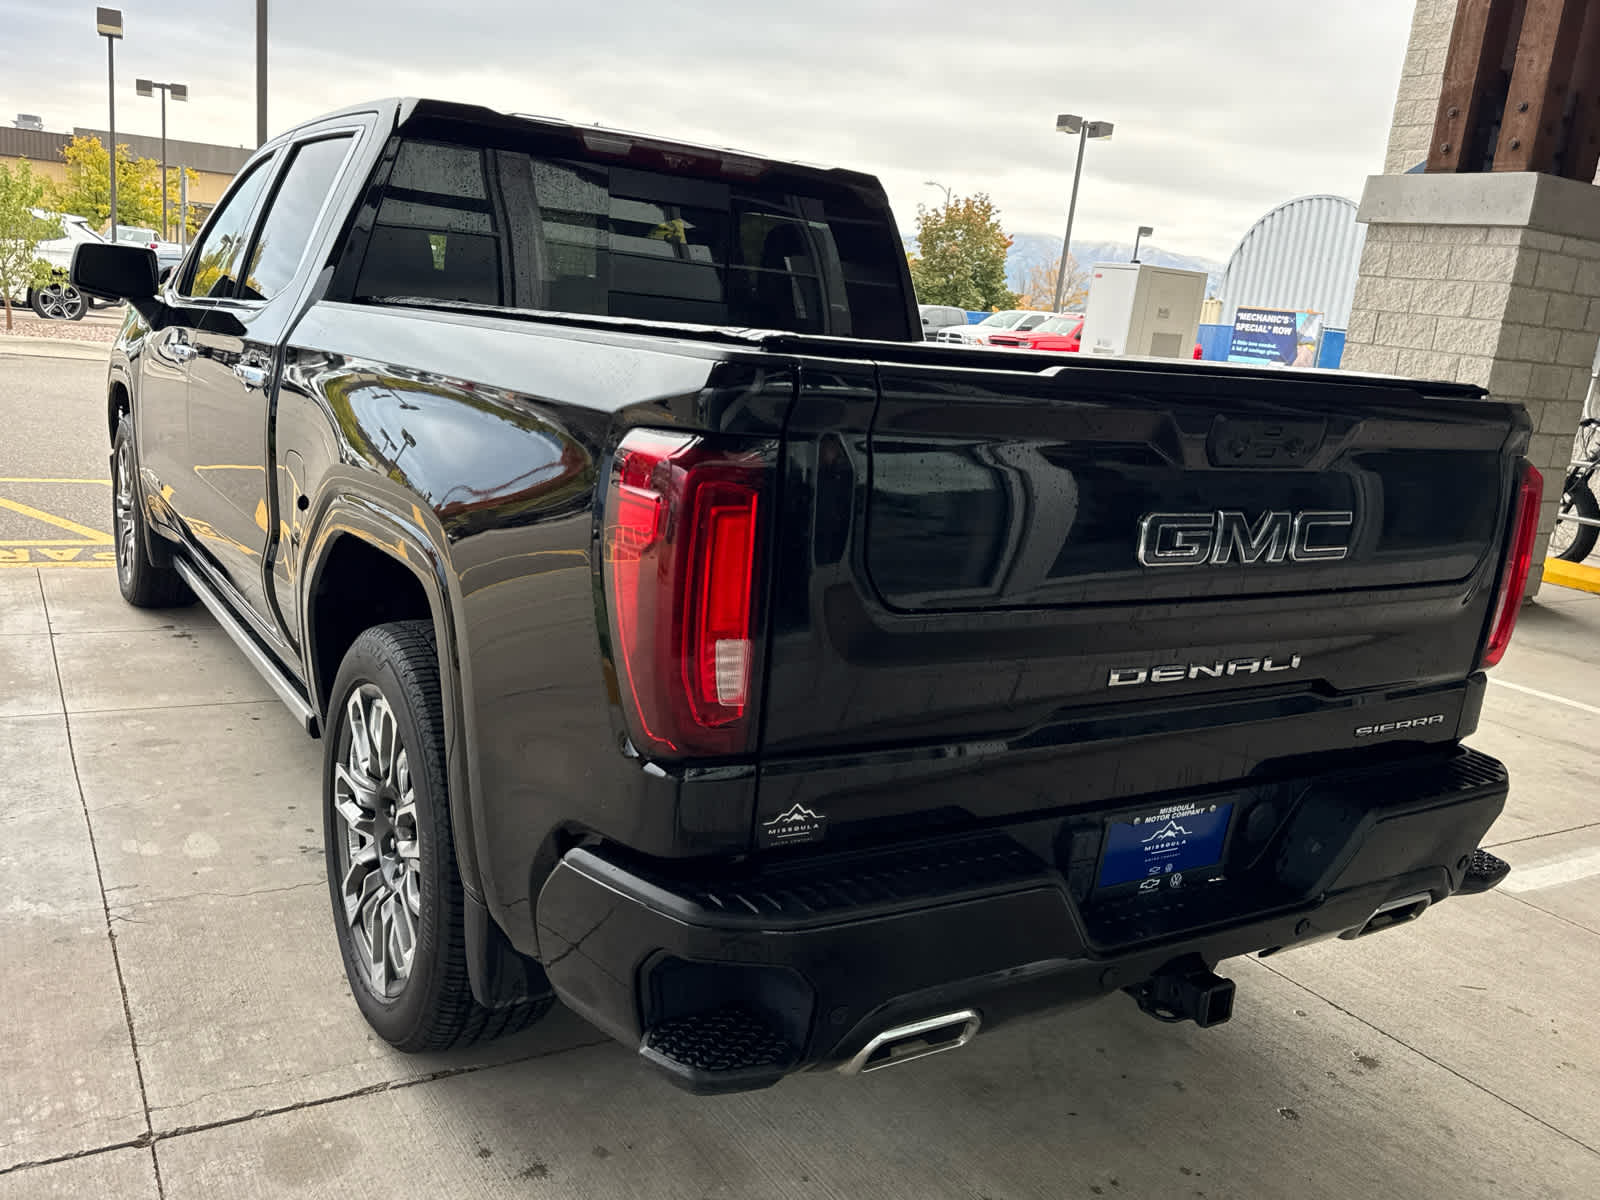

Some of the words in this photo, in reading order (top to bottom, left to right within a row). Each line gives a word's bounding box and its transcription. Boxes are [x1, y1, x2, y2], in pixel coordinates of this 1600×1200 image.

[1272, 326, 1292, 336] ROW
[1138, 510, 1352, 567] GMC
[1108, 655, 1300, 687] DENALI
[1354, 714, 1445, 737] SIERRA
[1144, 813, 1170, 824] MOTOR
[1171, 807, 1206, 819] COMPANY
[1159, 803, 1195, 815] MISSOULA
[768, 823, 819, 835] MISSOULA
[1144, 839, 1187, 852] MISSOULA
